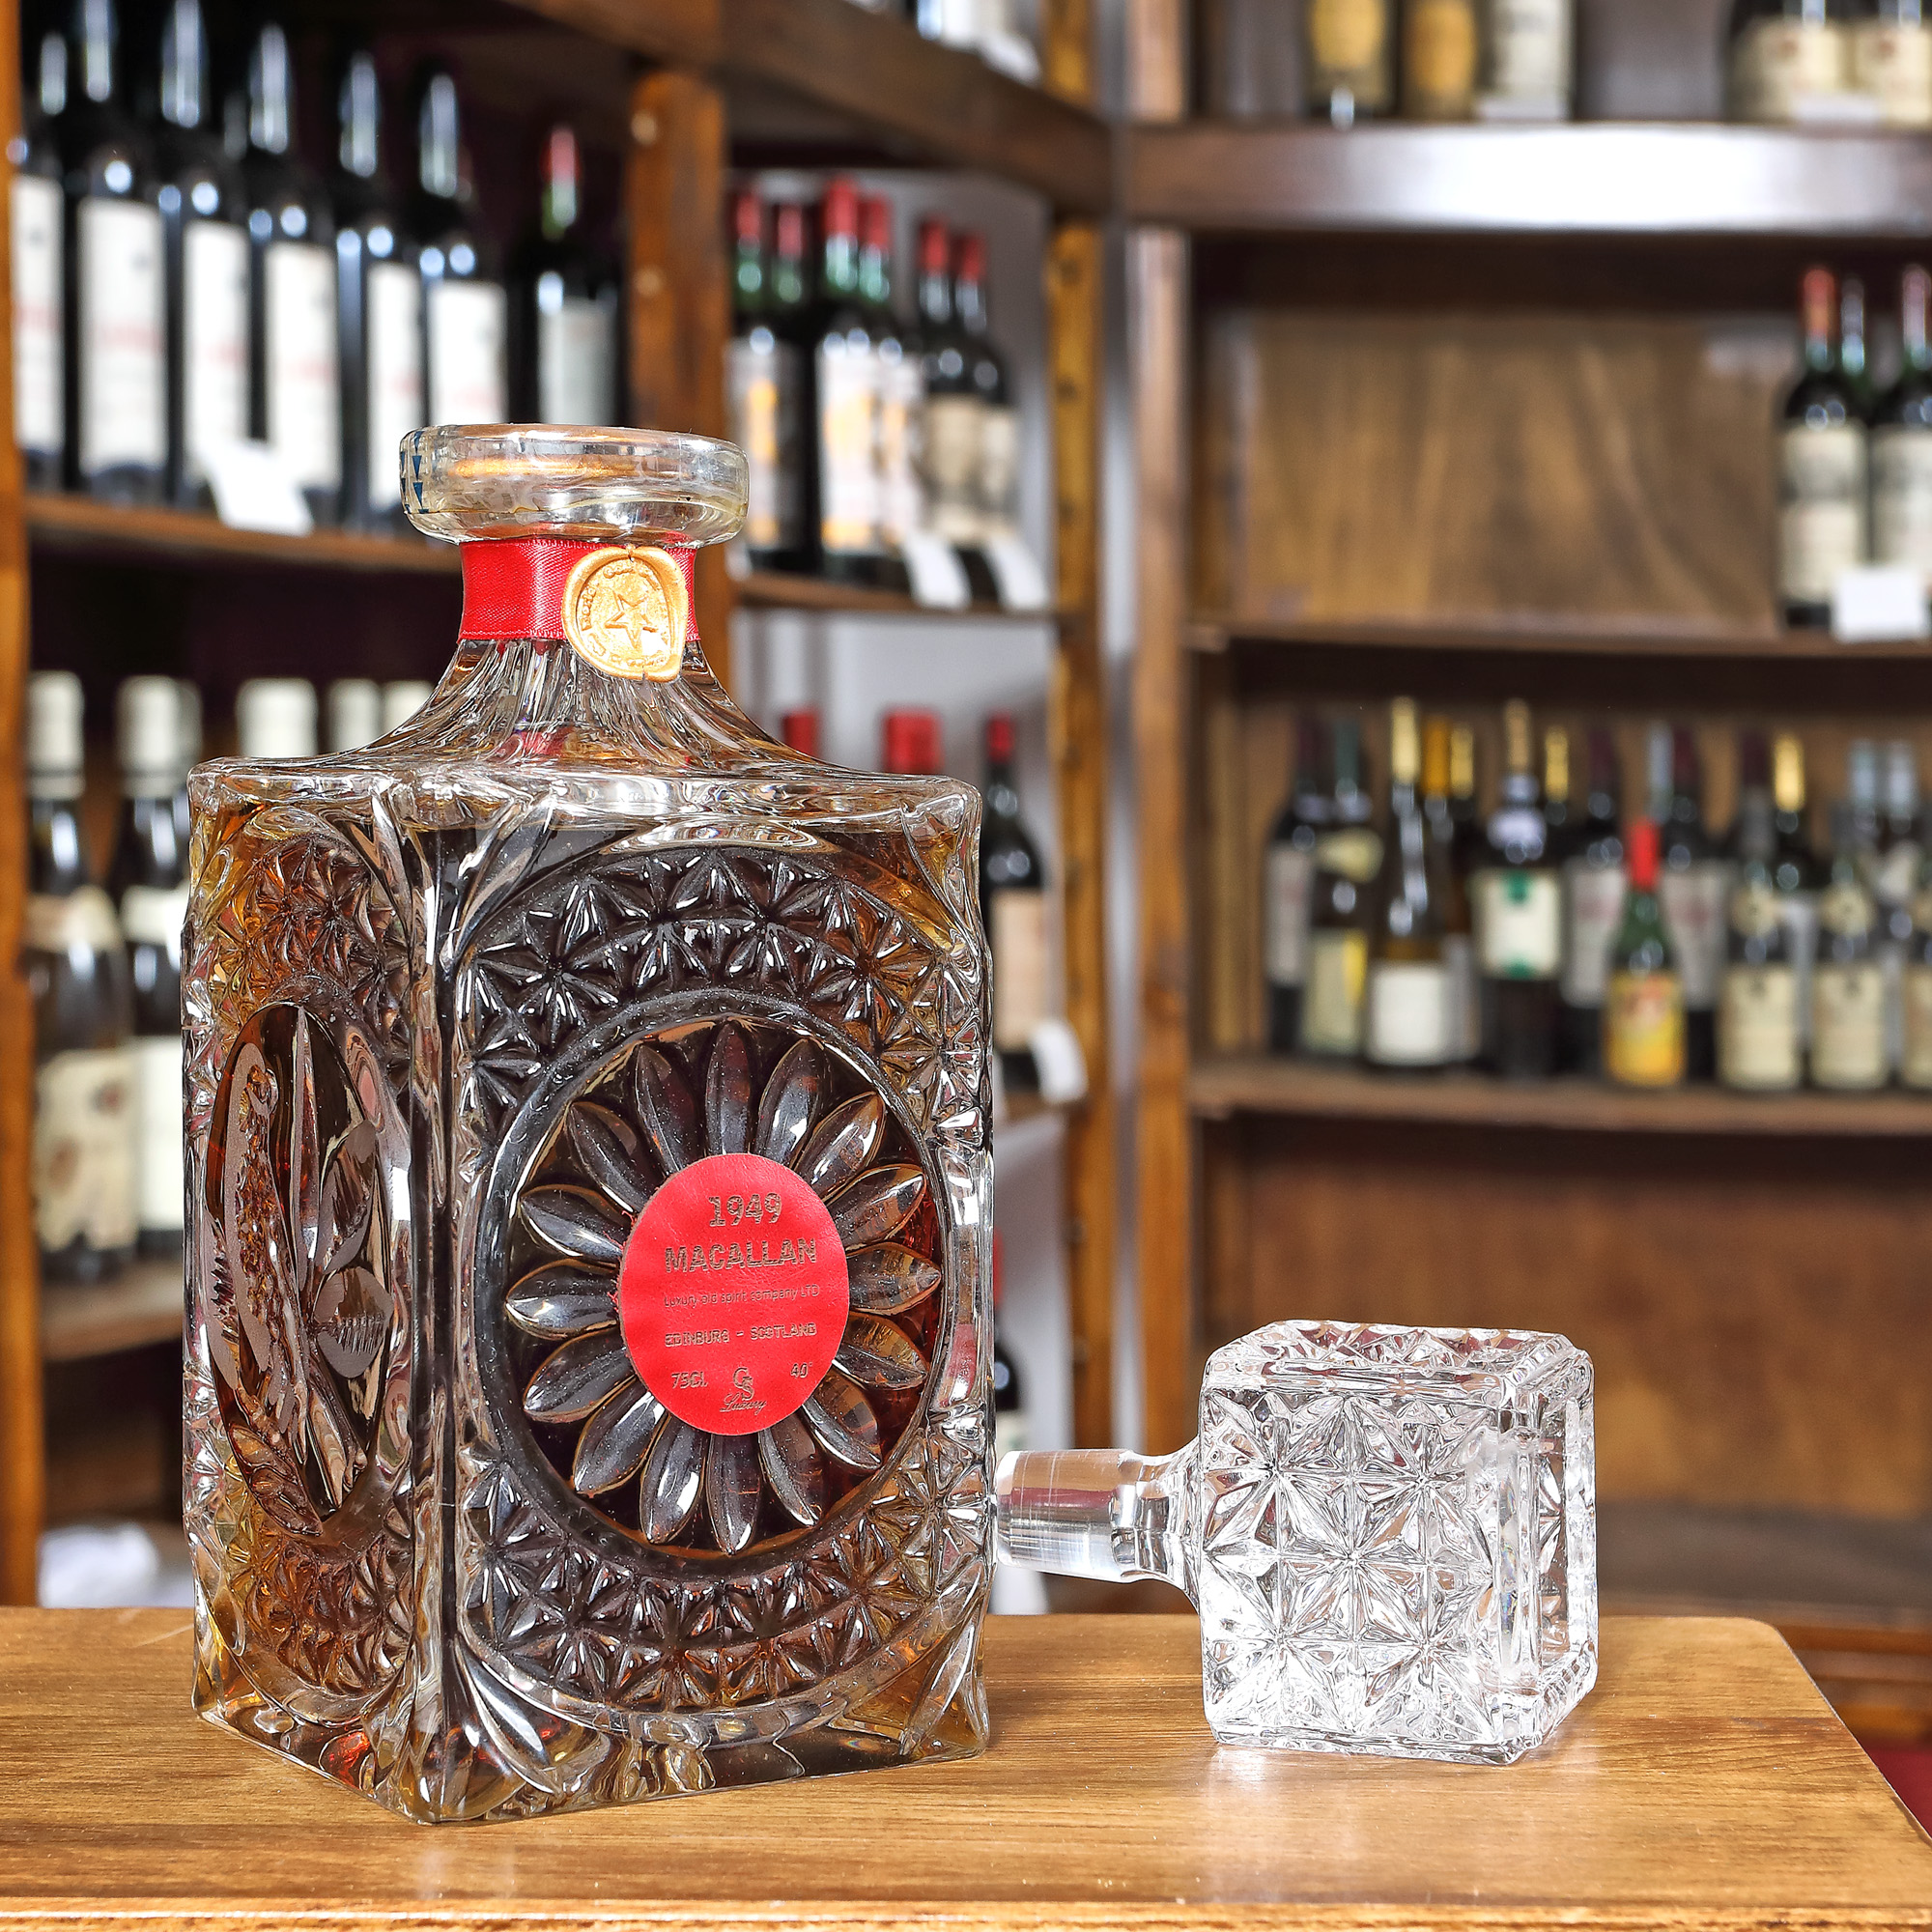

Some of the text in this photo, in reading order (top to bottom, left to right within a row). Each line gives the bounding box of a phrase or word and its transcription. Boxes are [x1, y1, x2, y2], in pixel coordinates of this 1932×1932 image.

[708, 1192, 782, 1227] 1949
[665, 1237, 817, 1273] MACALLAN
[664, 1294, 697, 1309] Luxury
[700, 1293, 718, 1305] old
[750, 1288, 798, 1302] company
[800, 1284, 820, 1297] LTD
[665, 1328, 730, 1348] EDINBURG
[750, 1321, 817, 1341] SCOTLAND
